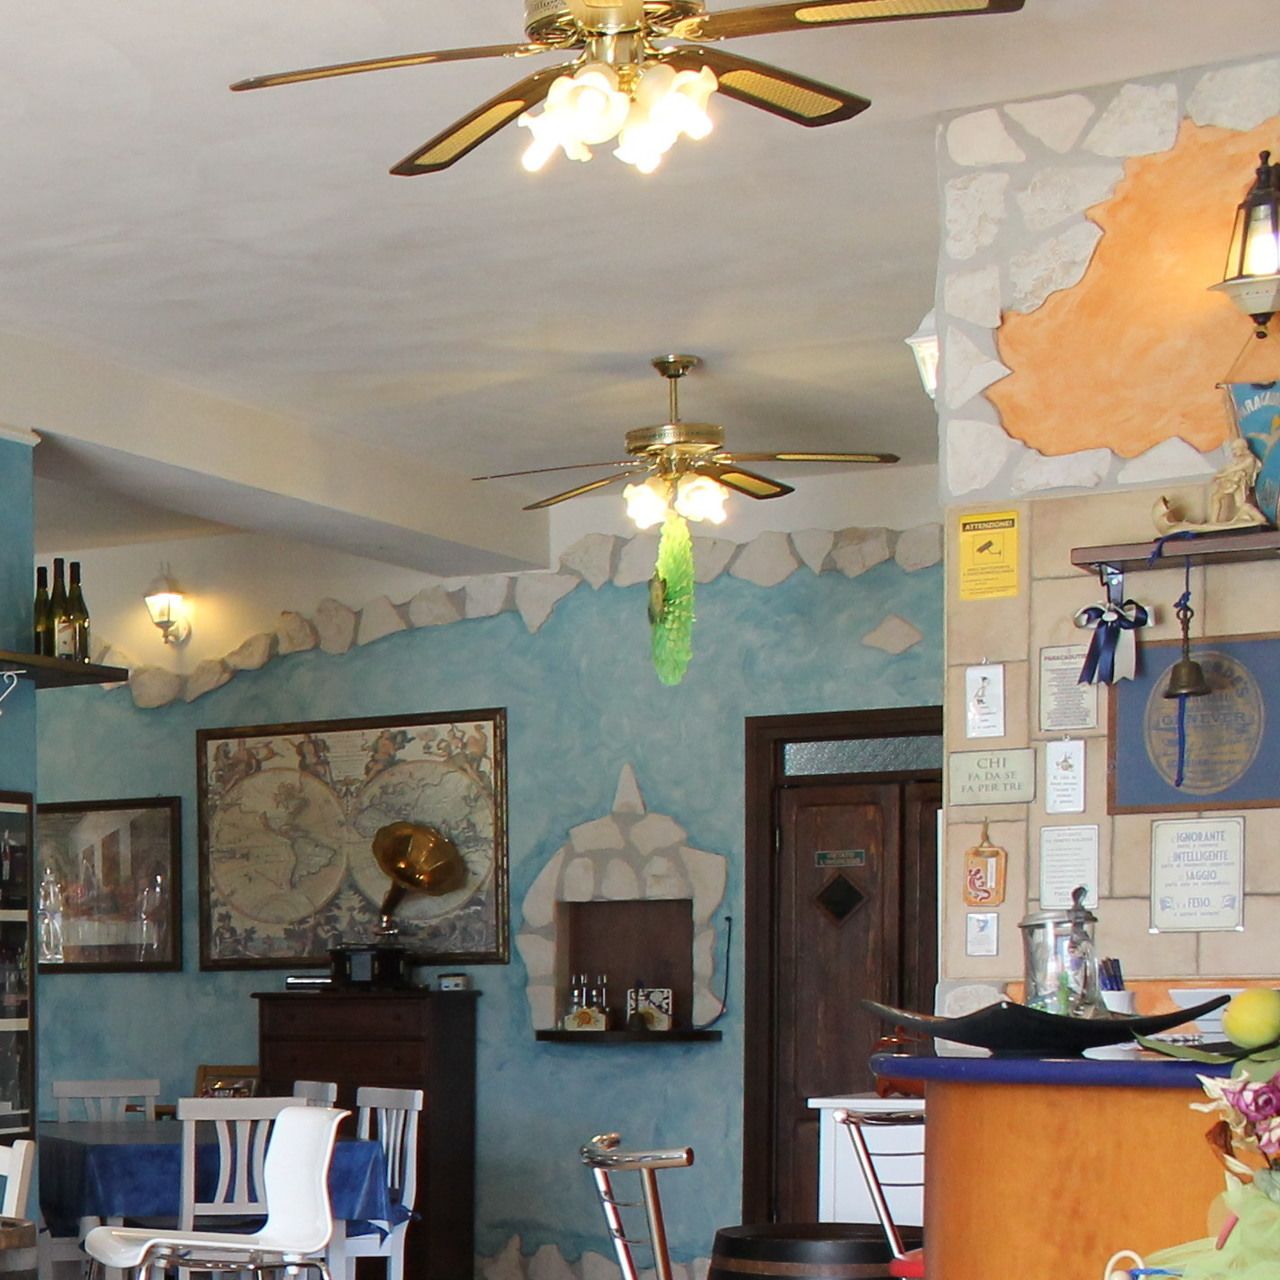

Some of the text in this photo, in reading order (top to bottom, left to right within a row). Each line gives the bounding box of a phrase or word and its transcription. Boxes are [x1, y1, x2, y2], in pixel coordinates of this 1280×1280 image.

[964, 519, 1013, 530] ATTENZIONE!
[1161, 712, 1246, 727] GNEVER
[977, 757, 1007, 770] CHI
[968, 772, 981, 782] FA
[985, 771, 1000, 781] DA
[961, 781, 1022, 793] FA PER TRE
[1186, 870, 1217, 881] SAGGIO
[1188, 897, 1211, 908] FESSO
